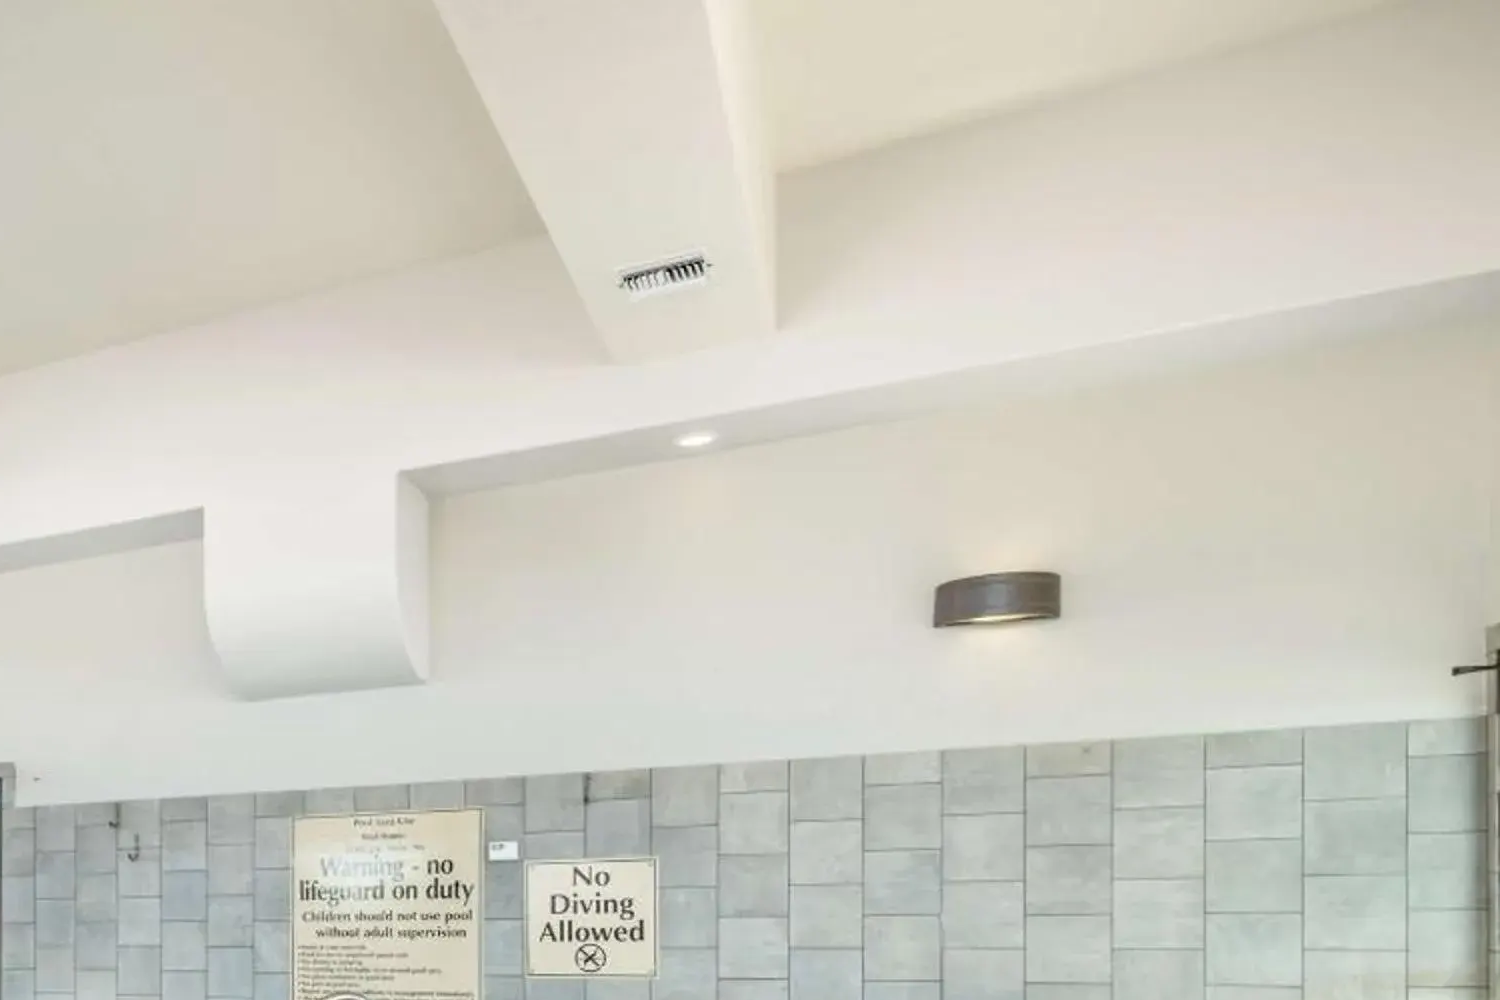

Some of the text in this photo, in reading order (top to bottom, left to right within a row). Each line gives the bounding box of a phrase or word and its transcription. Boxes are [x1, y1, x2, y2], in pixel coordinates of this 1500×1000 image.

[320, 856, 404, 883] Warning
[427, 858, 454, 875] no
[572, 865, 611, 887] No
[299, 877, 475, 907] lifeguard on duty
[302, 909, 473, 924] Children should not use pool
[550, 892, 635, 921] Diving
[315, 925, 467, 941] without adult supervision
[538, 919, 645, 943] Allowed
